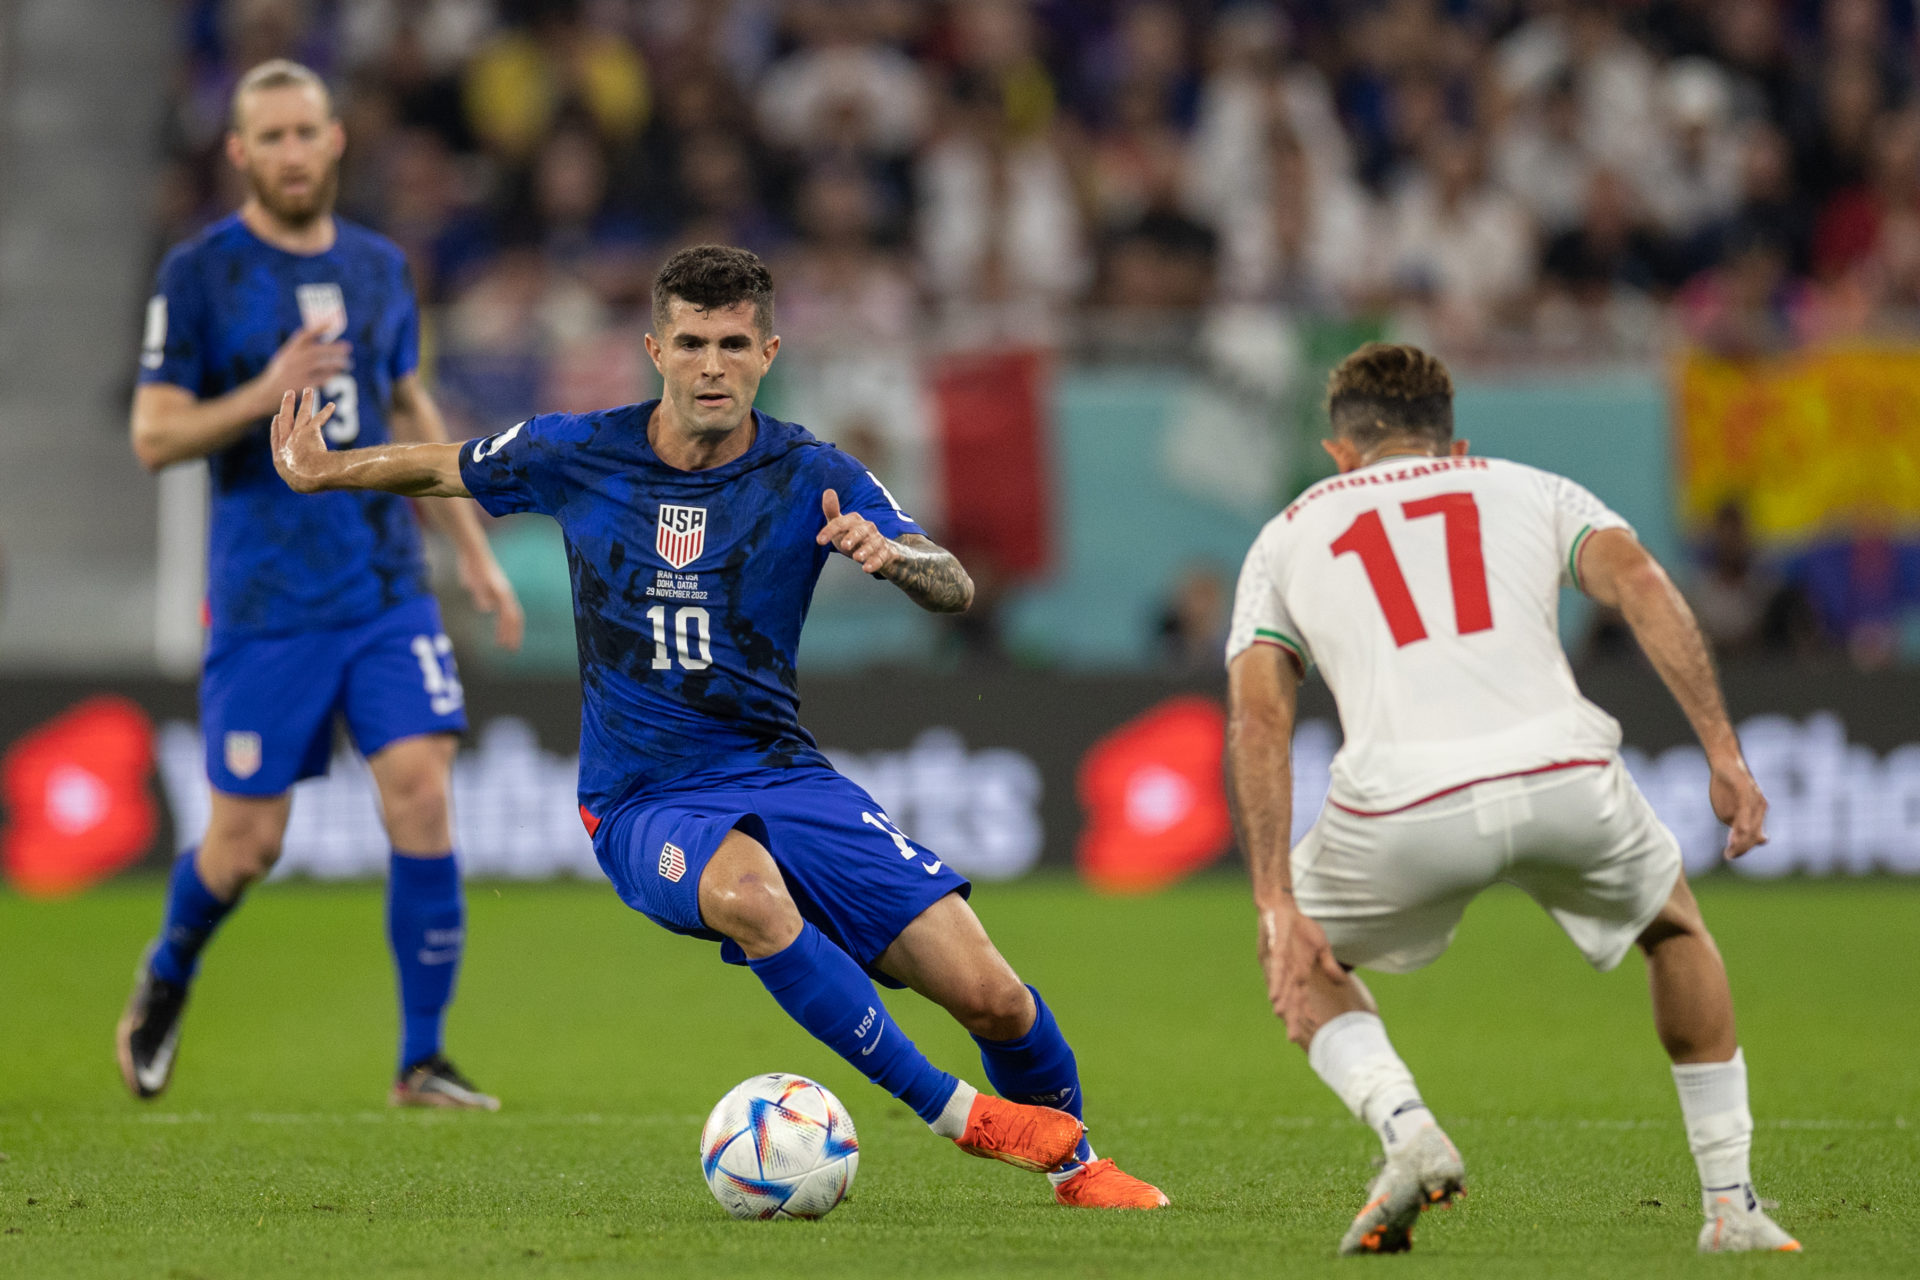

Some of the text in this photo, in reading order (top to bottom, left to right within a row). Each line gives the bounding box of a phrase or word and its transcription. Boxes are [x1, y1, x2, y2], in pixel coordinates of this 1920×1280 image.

[661, 507, 704, 533] USA
[656, 570, 673, 580] IRAN
[656, 579, 698, 590] DOHA, QATAR
[1329, 491, 1495, 650] 17
[646, 586, 709, 600] 29 NOVEMBER 2022
[646, 605, 714, 670] 10
[660, 844, 672, 875] USA
[853, 1006, 877, 1039] USA
